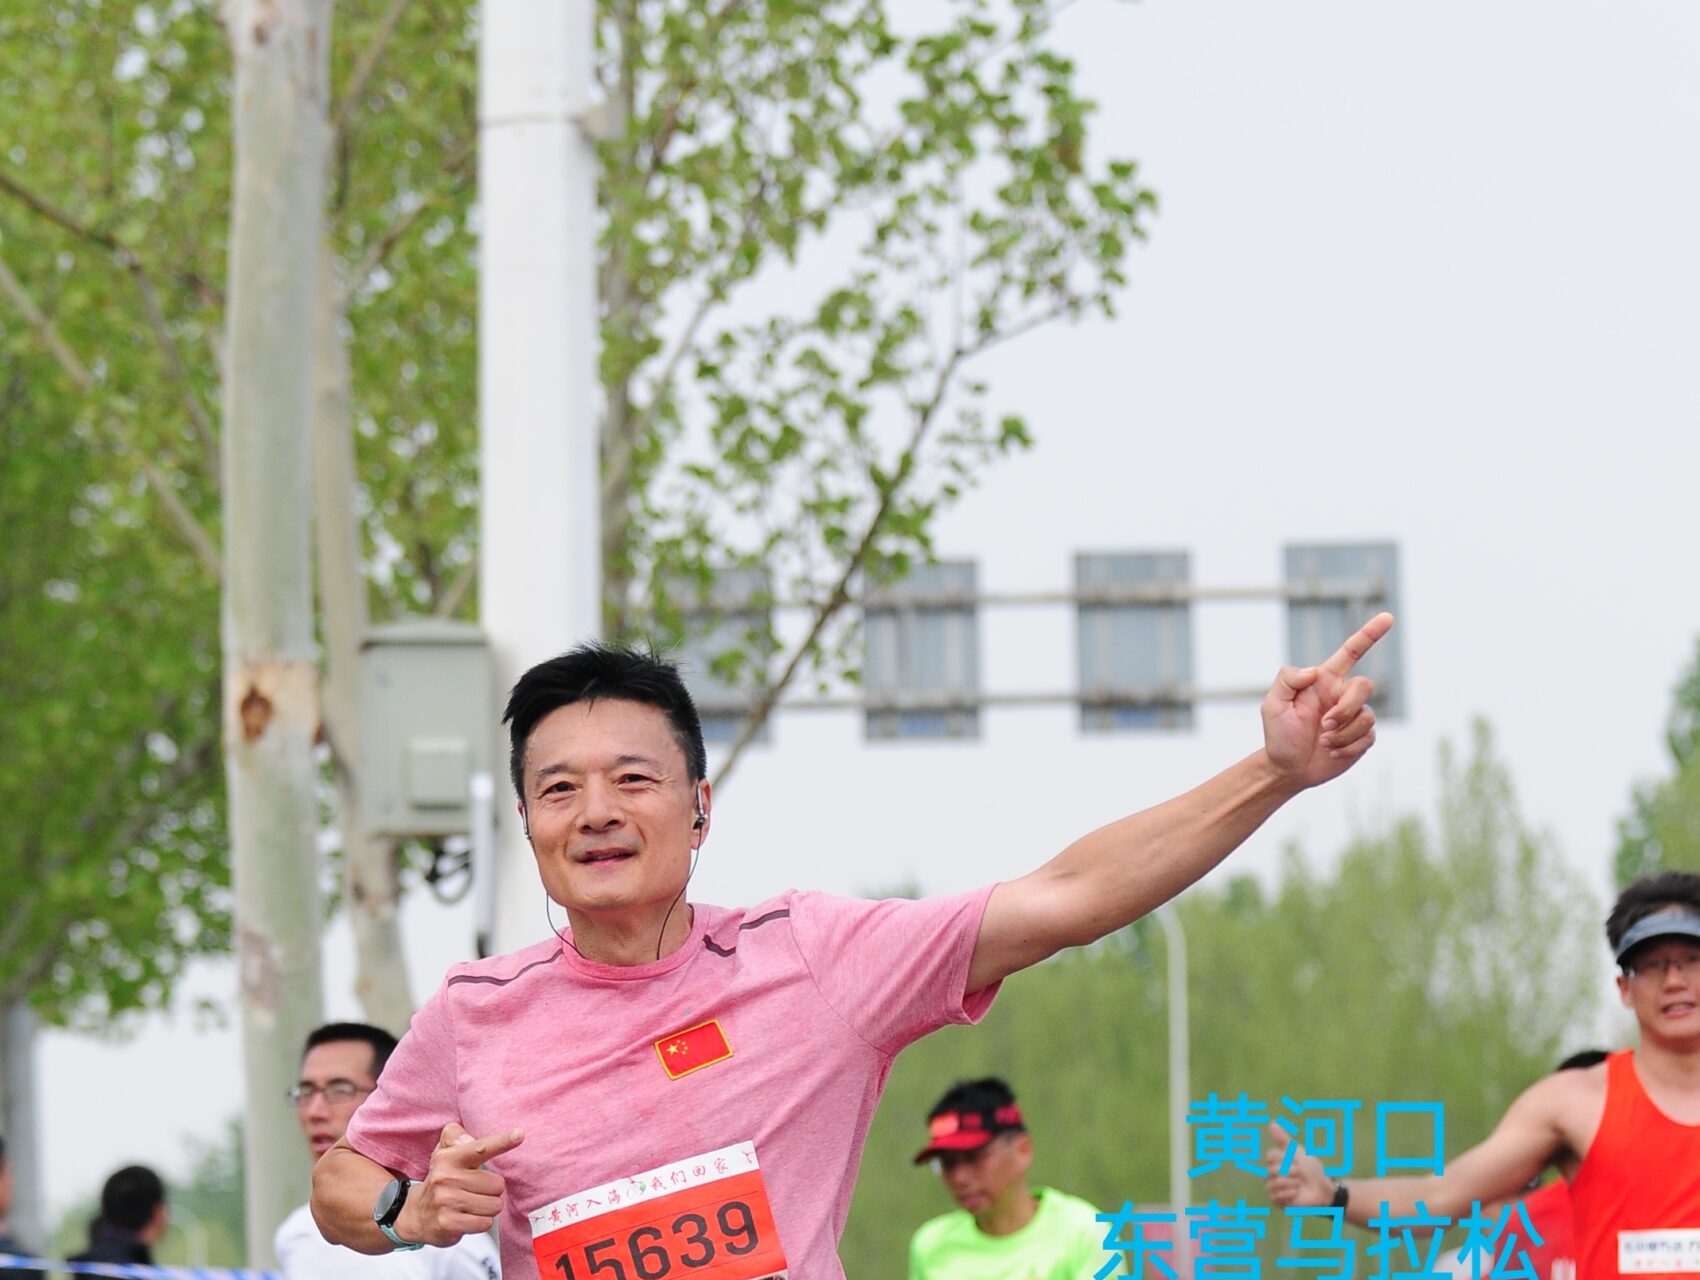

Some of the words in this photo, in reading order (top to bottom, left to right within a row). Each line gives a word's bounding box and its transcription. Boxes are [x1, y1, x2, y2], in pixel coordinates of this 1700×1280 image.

[548, 1188, 622, 1226] 黄河入海
[651, 1157, 729, 1191] 我们回家
